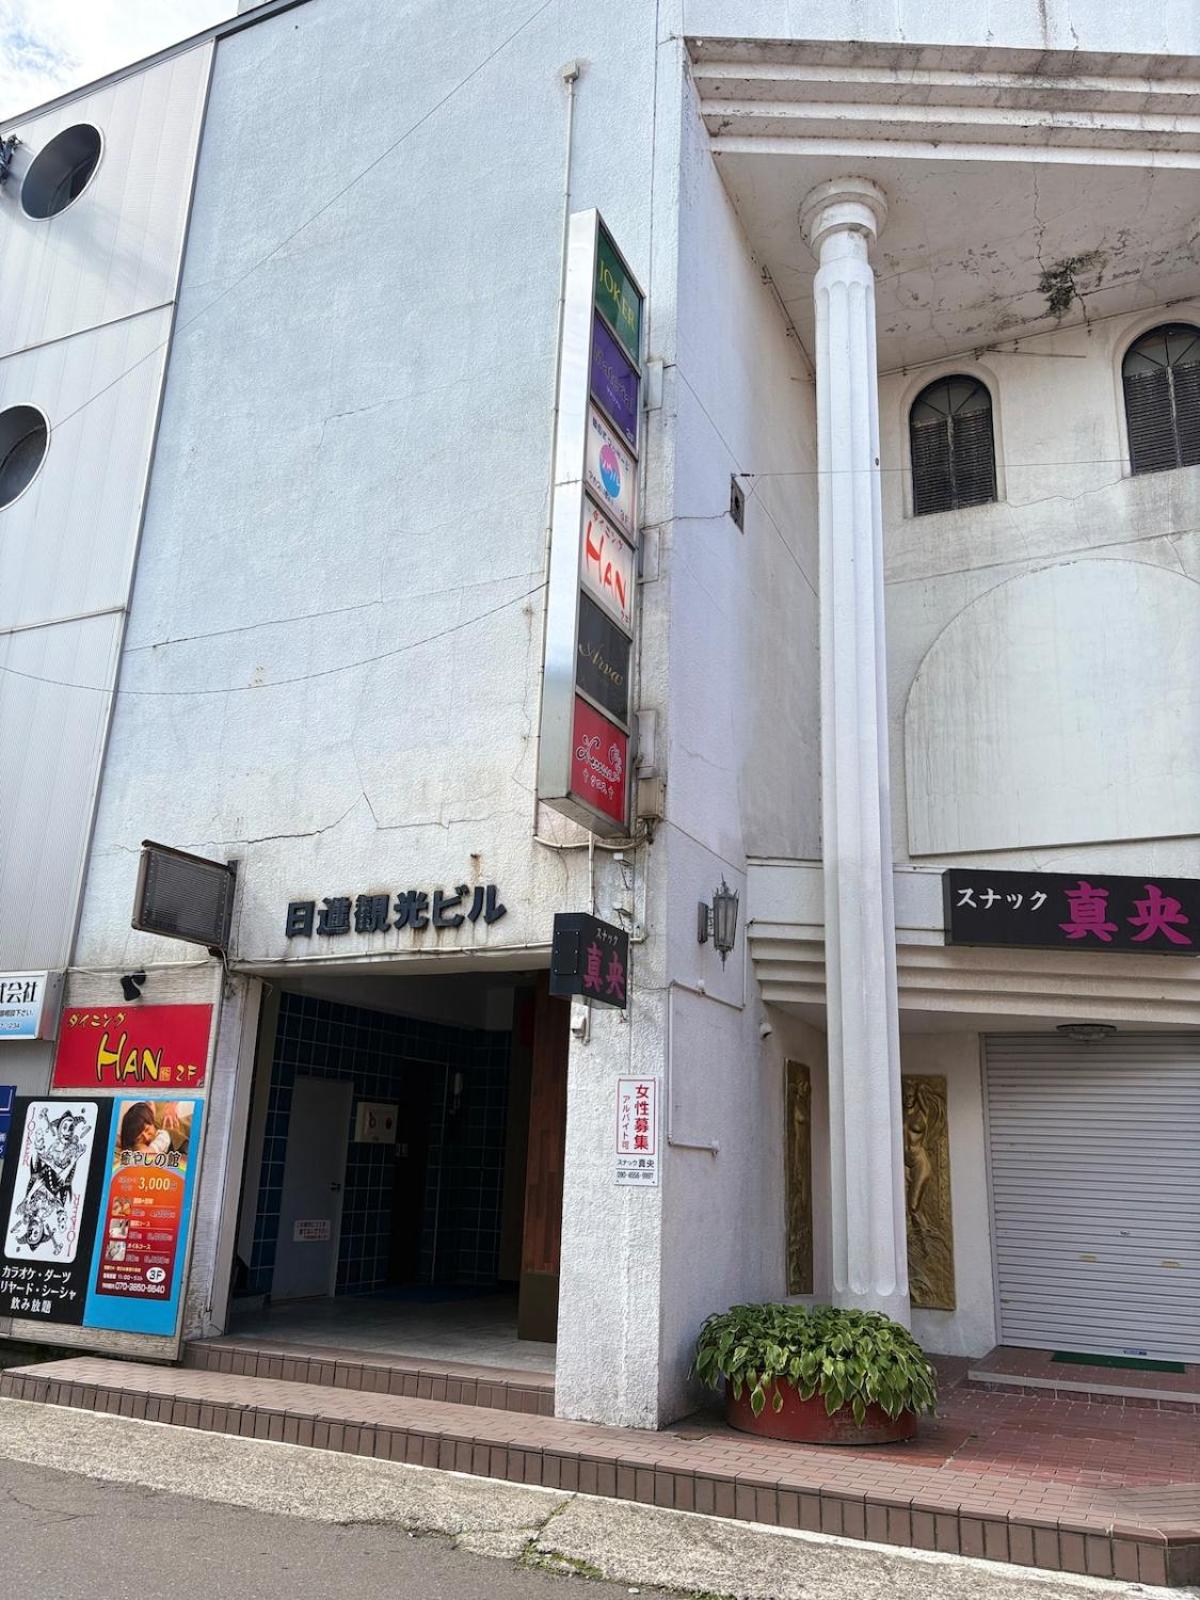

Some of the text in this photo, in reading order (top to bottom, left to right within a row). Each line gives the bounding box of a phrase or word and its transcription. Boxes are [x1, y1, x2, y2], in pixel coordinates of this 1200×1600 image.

[600, 259, 635, 333] JOKER
[586, 519, 627, 610] HAN
[285, 884, 507, 938] 日進観光ビル
[595, 927, 619, 946] スナック
[956, 880, 1193, 945] スナック 真央
[583, 942, 625, 1000] 真央
[69, 1012, 126, 1028] ダイニング
[97, 1031, 163, 1081] HAN
[176, 1064, 198, 1082] 2F
[634, 1083, 649, 1150] 女性募集
[1, 1265, 71, 1284] カラオケ・ダーツ
[149, 1269, 163, 1280] 3F
[10, 1296, 52, 1314] 飲み放題
